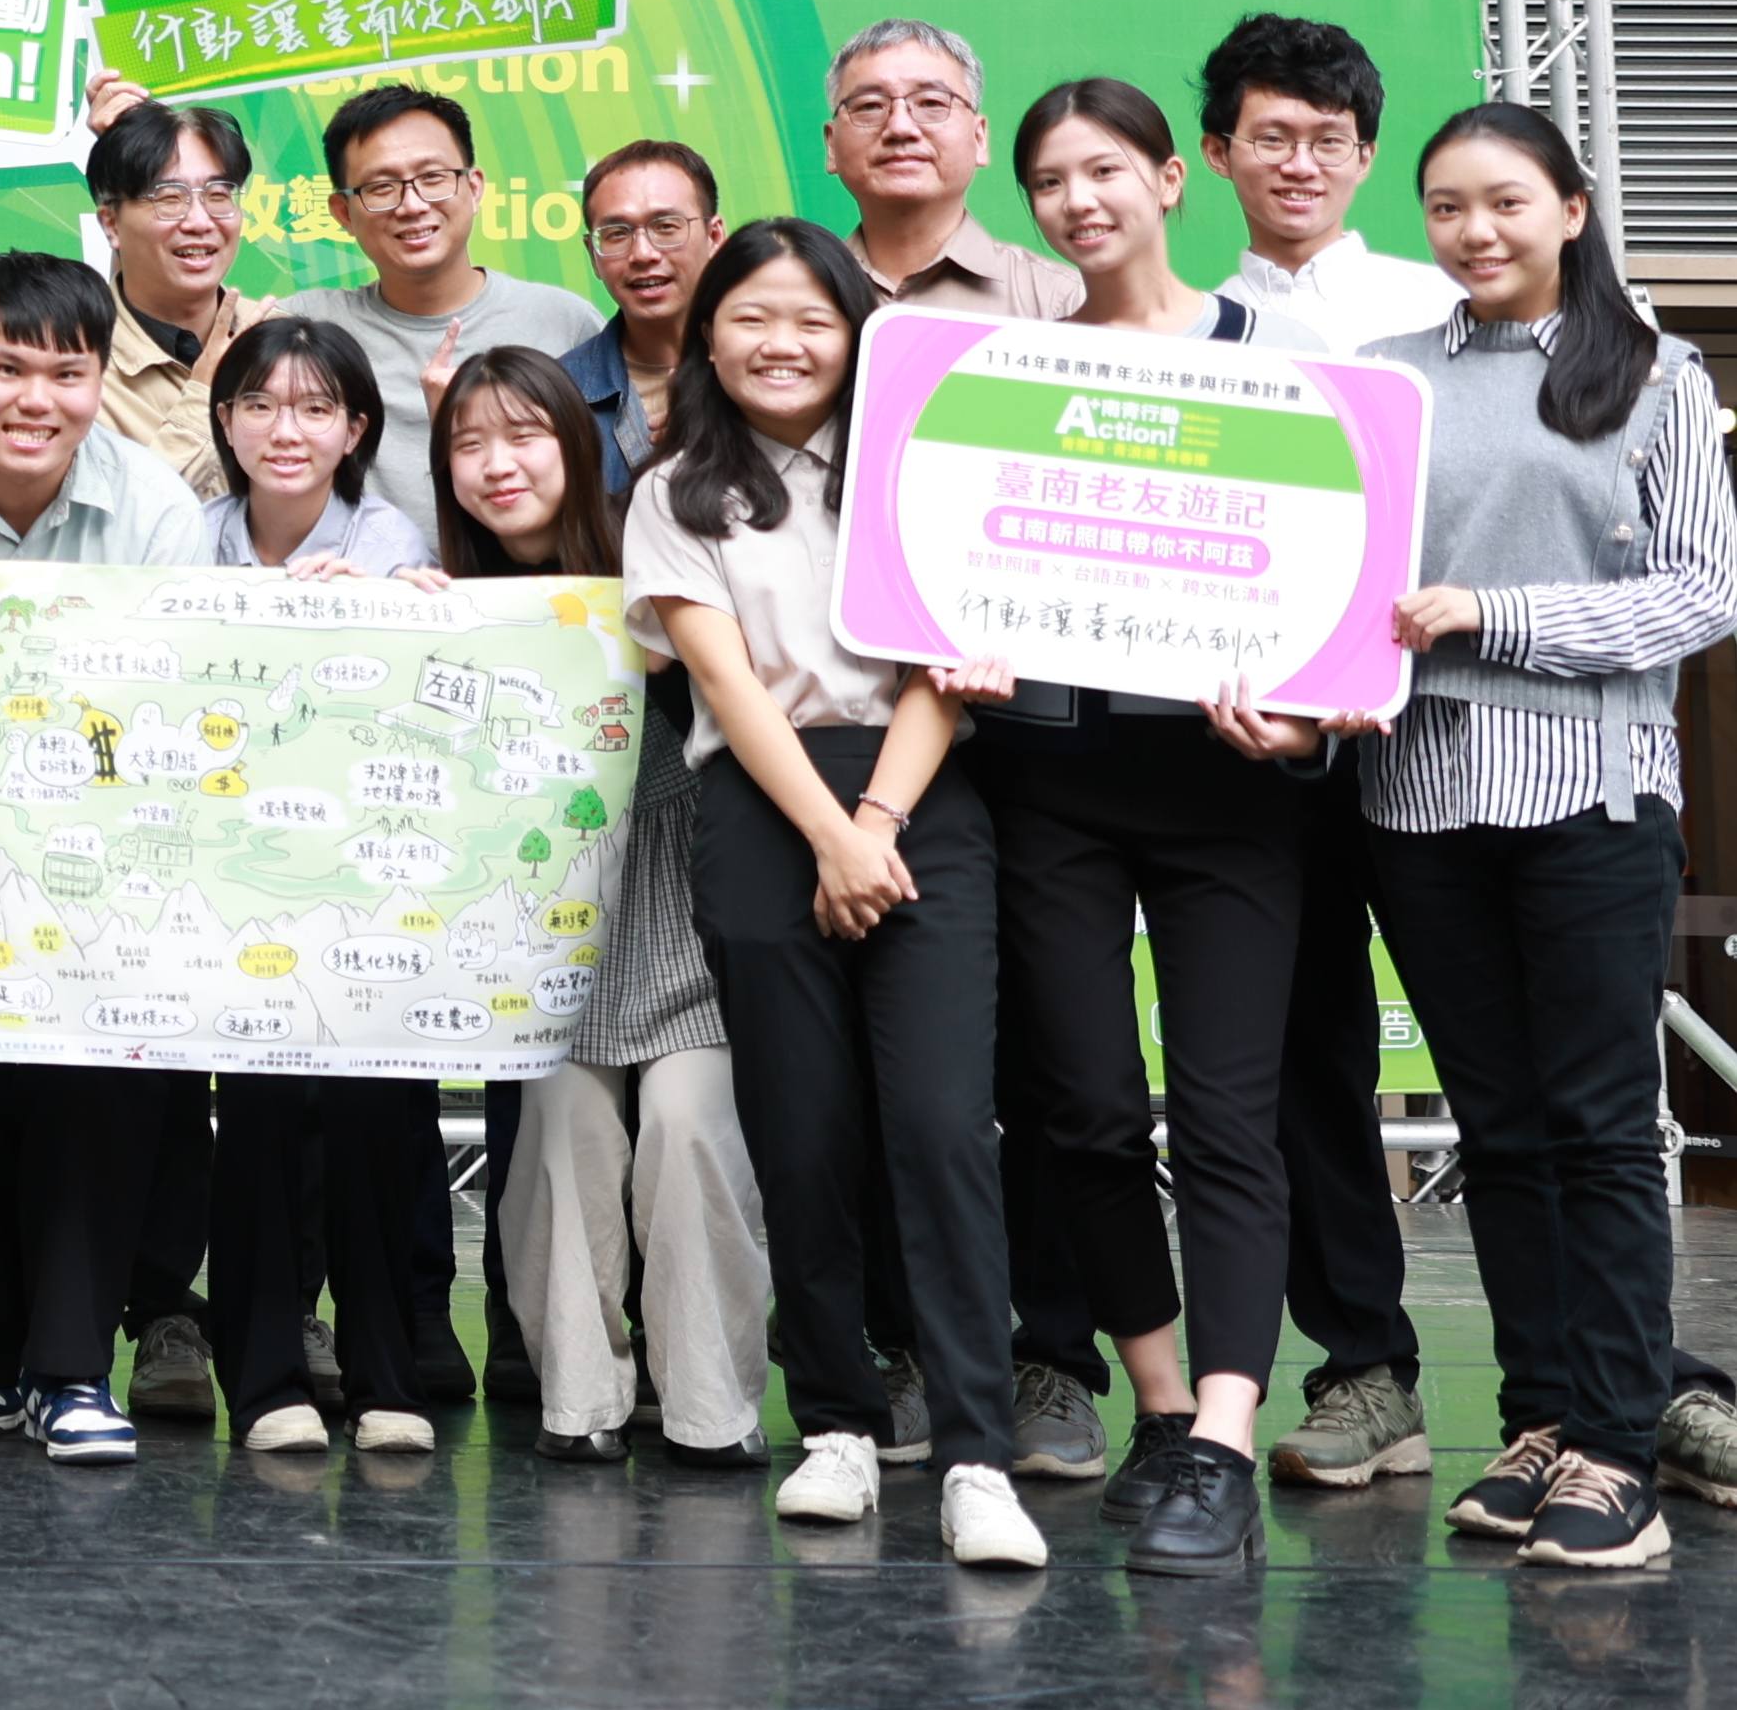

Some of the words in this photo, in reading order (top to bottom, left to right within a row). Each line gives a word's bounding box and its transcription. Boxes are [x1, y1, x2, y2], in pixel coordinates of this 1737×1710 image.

[984, 348, 1303, 404] 114年臺南青年公共參與行動計畫
[993, 460, 1268, 531] 臺南老友遊記
[966, 548, 1043, 576] 智慧照護
[1073, 562, 1151, 591] 台語互動
[997, 514, 1256, 570] 臺南新照護帶你不阿茲
[424, 670, 478, 716] 左鎮
